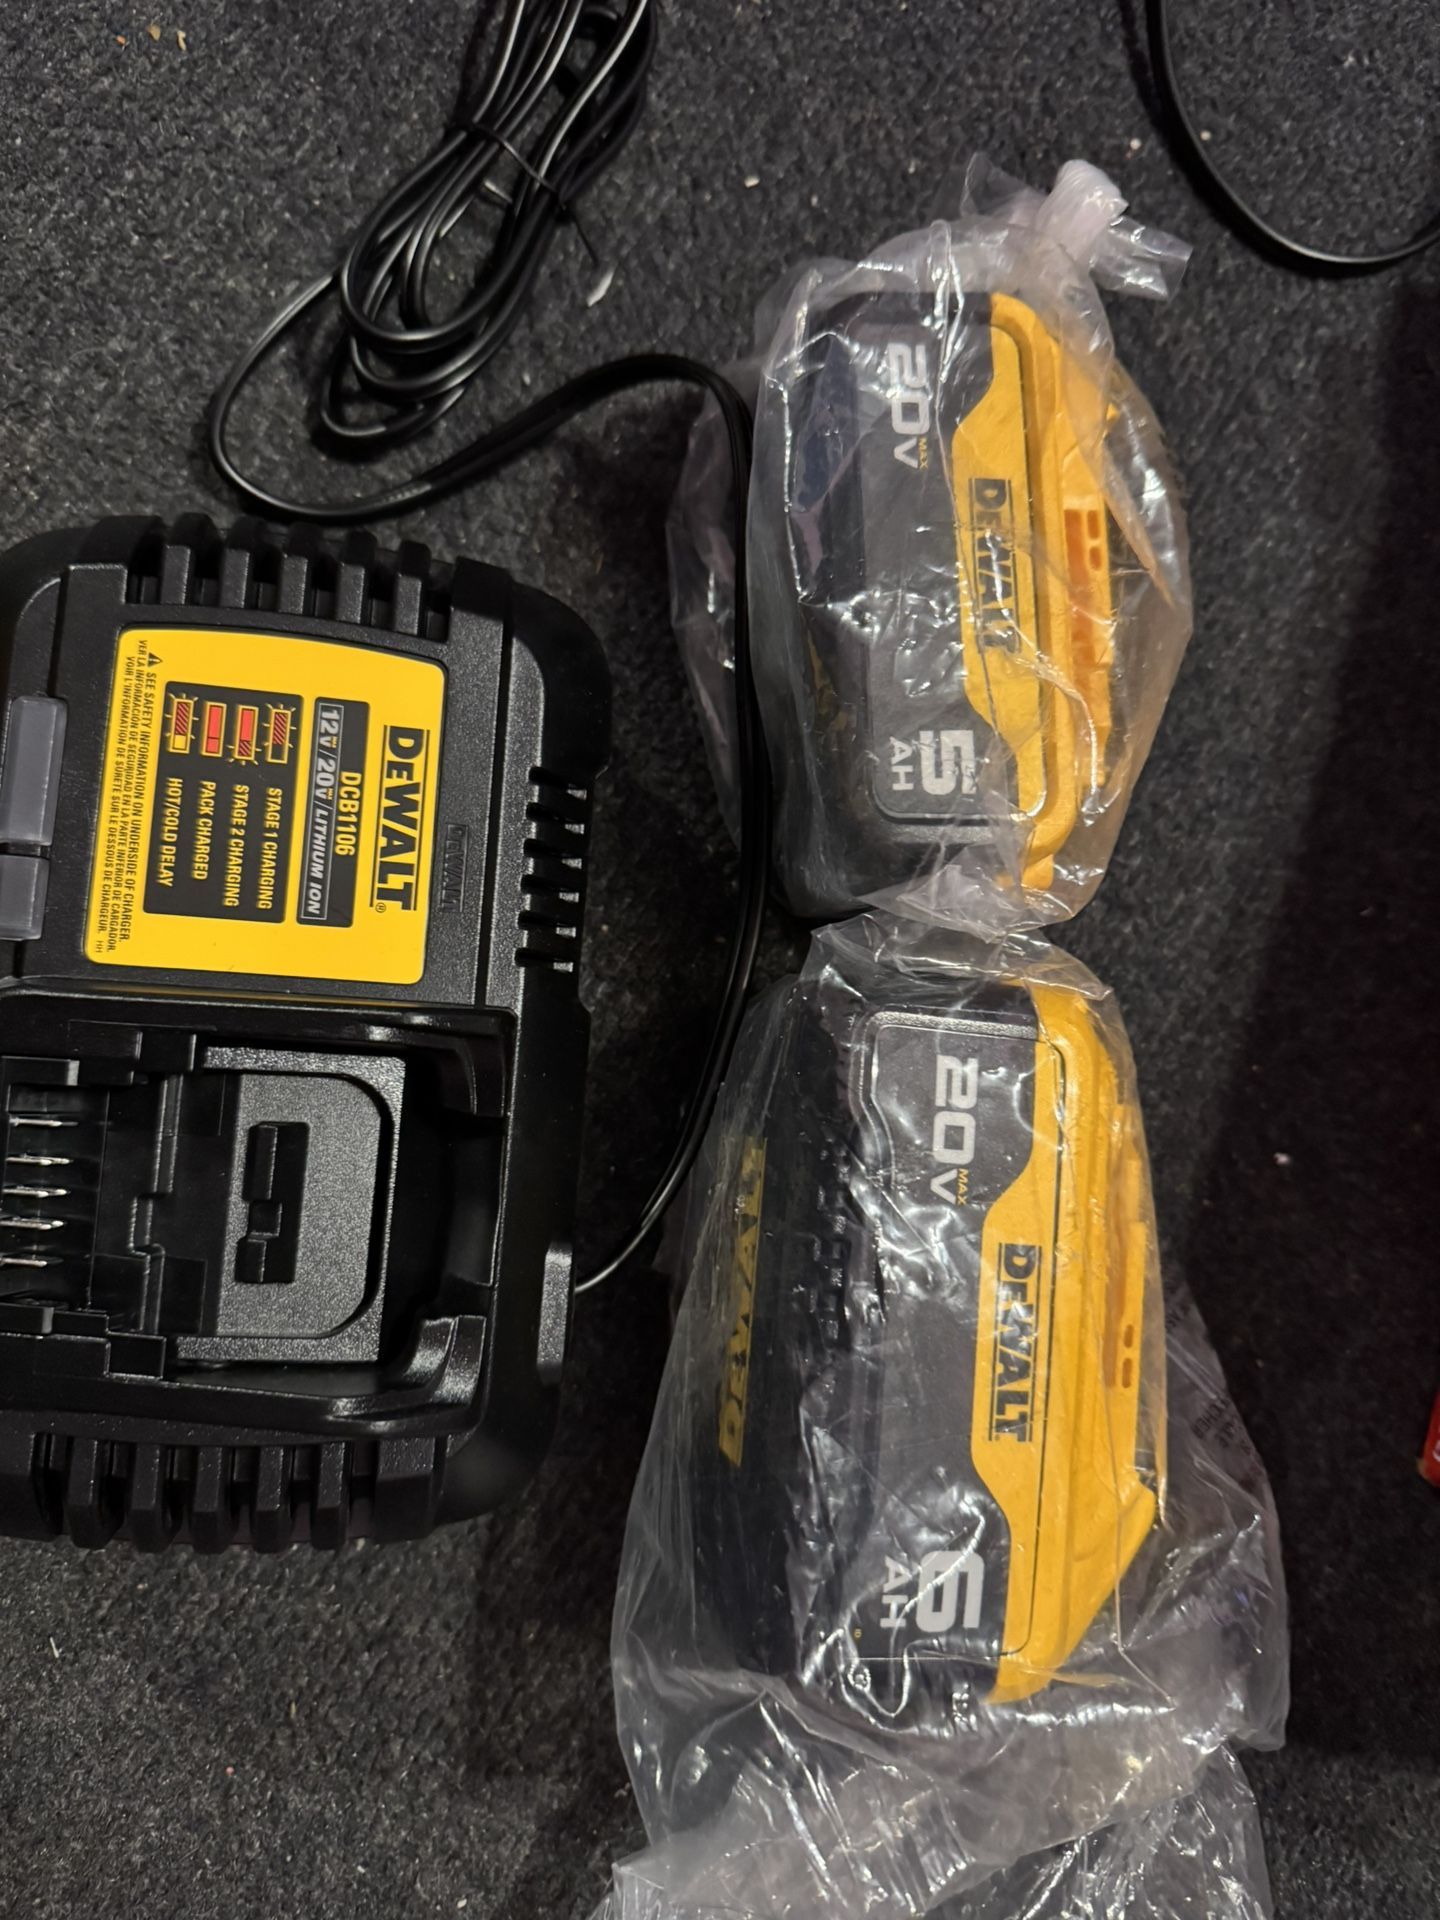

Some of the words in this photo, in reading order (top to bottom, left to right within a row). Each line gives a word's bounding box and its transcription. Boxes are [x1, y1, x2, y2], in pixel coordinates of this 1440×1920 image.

[888, 342, 932, 469] 20V
[919, 437, 928, 469] MAX
[125, 656, 136, 676] VOIR
[137, 657, 146, 668] LA
[138, 640, 148, 655] VER
[146, 672, 157, 689] SEE
[141, 692, 155, 729] SAFETY
[116, 747, 127, 757] DE
[129, 731, 140, 741] DE
[124, 744, 137, 792] SEGURIDAD
[134, 731, 151, 799] INFORMATION
[889, 736, 914, 790] AH
[919, 729, 977, 795] 5
[110, 795, 121, 813] SUR
[121, 808, 130, 819] LA
[122, 794, 132, 806] EN
[132, 802, 144, 817] ON
[163, 777, 183, 842] HOT/COLD
[199, 781, 217, 815] PACK
[232, 784, 250, 826] STAGE
[265, 787, 283, 829] STAGE
[334, 771, 362, 856] DCB1106
[109, 815, 119, 825] LE
[117, 820, 129, 848] PARTE
[231, 828, 245, 836] 2
[104, 827, 118, 868] DESSOUS
[126, 820, 142, 876] UNDERSIDE
[157, 845, 177, 887] DELAY
[192, 818, 213, 880] CHARGED
[103, 870, 114, 881] DE
[113, 849, 126, 887] INFERIOR
[125, 878, 136, 891] OF
[224, 839, 245, 907] CHARGING
[257, 841, 278, 909] CHARGING
[98, 883, 113, 934] CHARGEUR.
[111, 890, 122, 901] DE
[307, 882, 323, 914] ION
[107, 903, 121, 953] CARGADOR.
[118, 894, 134, 942] CHARGER.
[929, 1054, 979, 1205] 20V
[957, 1168, 969, 1205] MAX
[995, 1243, 1038, 1442] DEWALT
[880, 1556, 912, 1628] AH
[915, 1551, 985, 1633] 6
